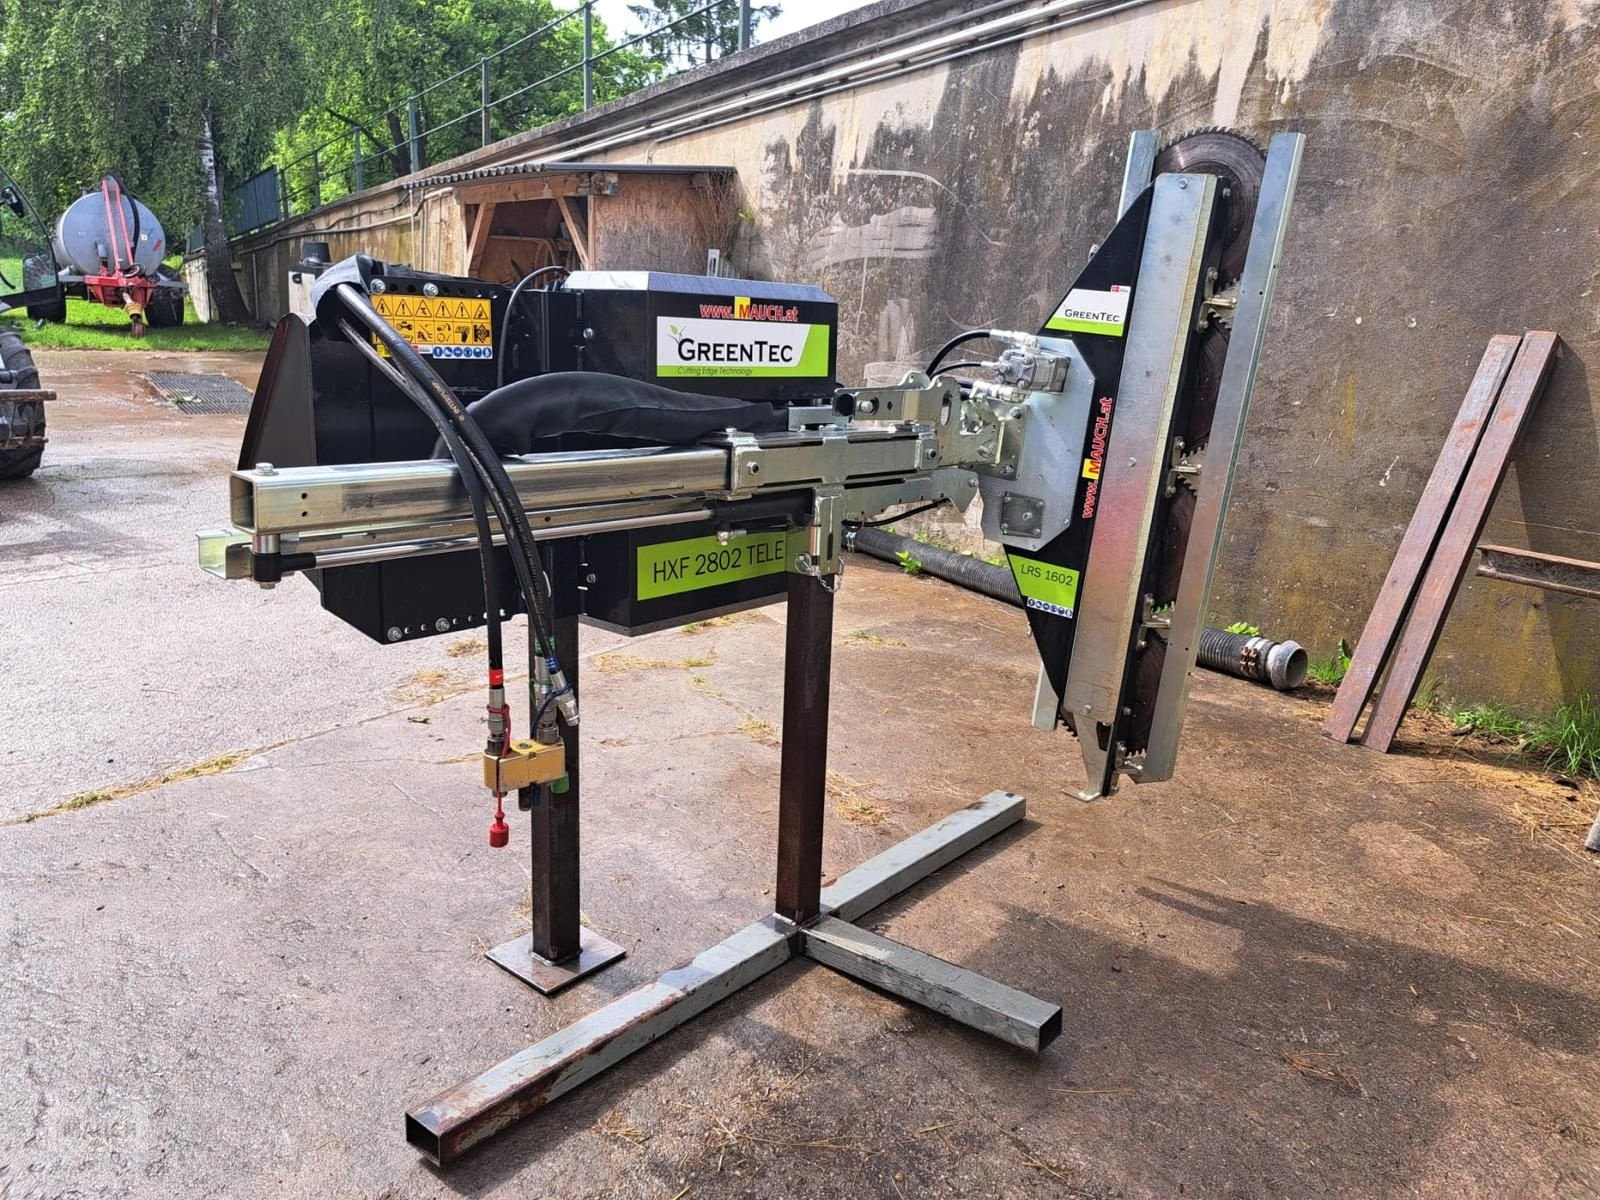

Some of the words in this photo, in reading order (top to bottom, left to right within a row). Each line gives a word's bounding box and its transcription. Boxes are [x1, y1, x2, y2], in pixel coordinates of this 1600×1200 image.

[700, 303, 798, 322] www.MAUCH.at
[677, 366, 701, 376] Cutting
[702, 366, 718, 376] Edge
[719, 366, 753, 376] Technology
[1082, 396, 1112, 519] www.MAUCH.at
[653, 556, 690, 584] HXF
[695, 547, 742, 576] 2802
[747, 540, 785, 565] TELE
[1021, 564, 1042, 578] LRS
[1045, 570, 1074, 587] 1602
